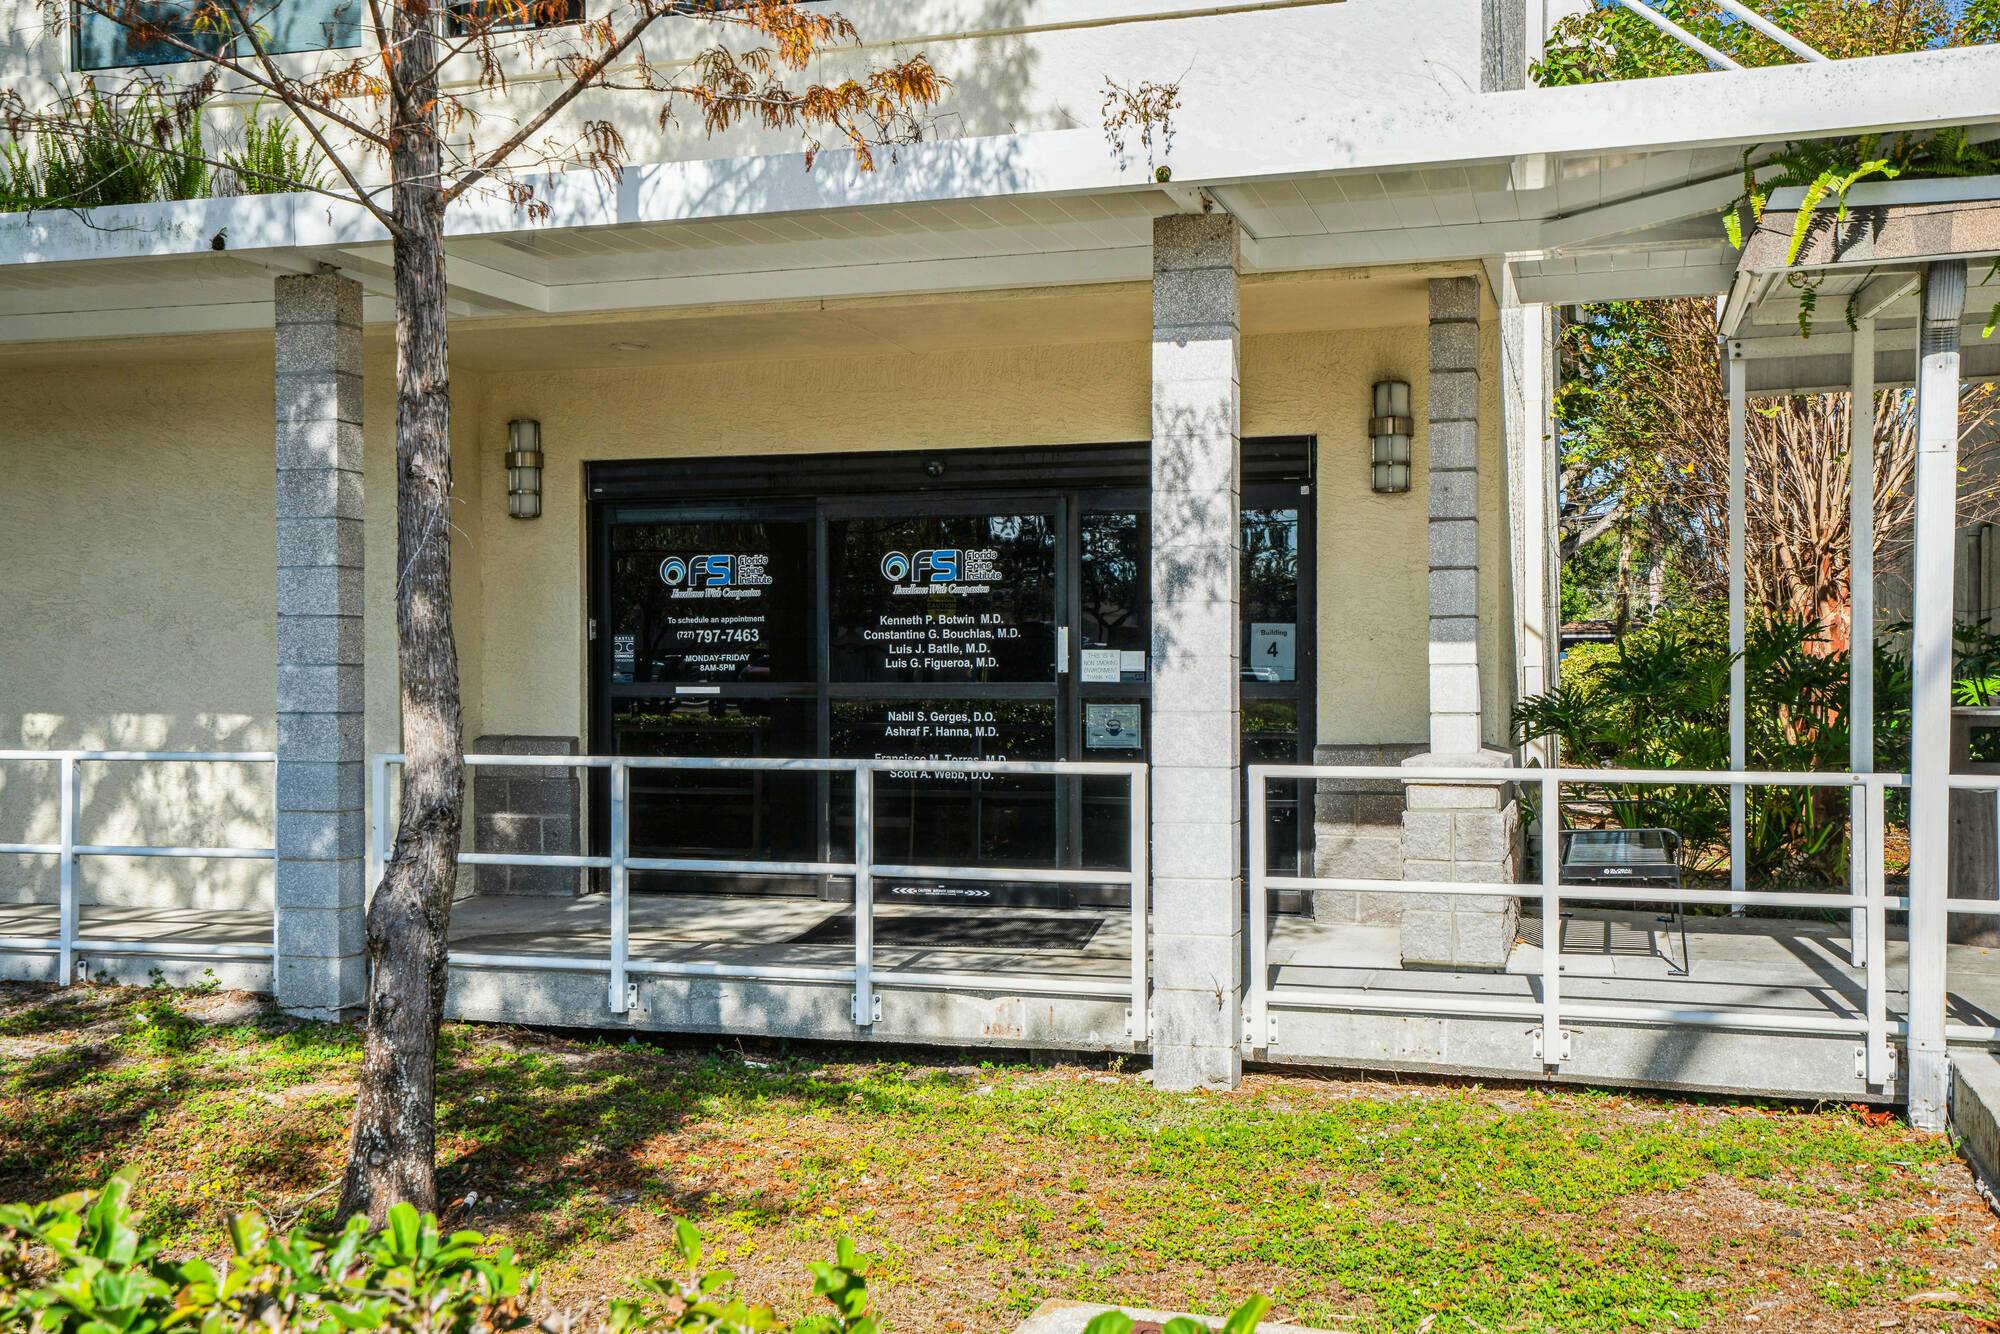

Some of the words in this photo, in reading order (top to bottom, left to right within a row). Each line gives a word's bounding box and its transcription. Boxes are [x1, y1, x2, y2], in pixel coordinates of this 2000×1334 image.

[738, 554, 768, 565] Florida
[966, 549, 998, 560] Florida
[688, 554, 736, 586] FSI
[912, 549, 964, 582] FSI
[966, 561, 992, 572] Spine
[739, 566, 764, 577] Spine
[966, 571, 1002, 580] Institute
[738, 575, 772, 585] Institute
[705, 586, 722, 598] With
[892, 584, 929, 595] Excellence
[929, 583, 947, 594] With
[948, 584, 990, 596] Compassion
[721, 615, 765, 624] appointment
[880, 615, 922, 625] Kenneth
[926, 615, 936, 625] P.
[939, 614, 975, 625] Botwin
[981, 614, 1004, 624] M.D.
[676, 631, 695, 640] (727)
[696, 629, 759, 643] 797-7463
[864, 630, 925, 640] Constantine
[928, 630, 940, 639] G.
[943, 629, 994, 640] Bouchlas,
[998, 628, 1021, 638] M.D.
[889, 644, 912, 654] Luis
[915, 644, 924, 654] J.
[928, 644, 963, 655] Batlle,
[966, 644, 990, 653] M.D.
[1267, 641, 1278, 658] 4
[686, 654, 750, 662] MONDAY-FRIDAY
[885, 658, 907, 668] Luis
[910, 658, 921, 668] G.
[924, 658, 973, 670] Figueroa,
[976, 658, 999, 667] M.D.
[888, 711, 914, 722] Nabil
[917, 711, 927, 721] S.
[930, 712, 971, 724] Gerges,
[974, 712, 996, 722] D.O.
[885, 726, 920, 737] Ashraf
[923, 727, 932, 737] F.
[935, 727, 972, 738] Hanna,
[975, 727, 999, 737] M.D.
[890, 770, 917, 778] Scott
[934, 771, 968, 781] Webb,
[971, 771, 994, 780] D.O.
